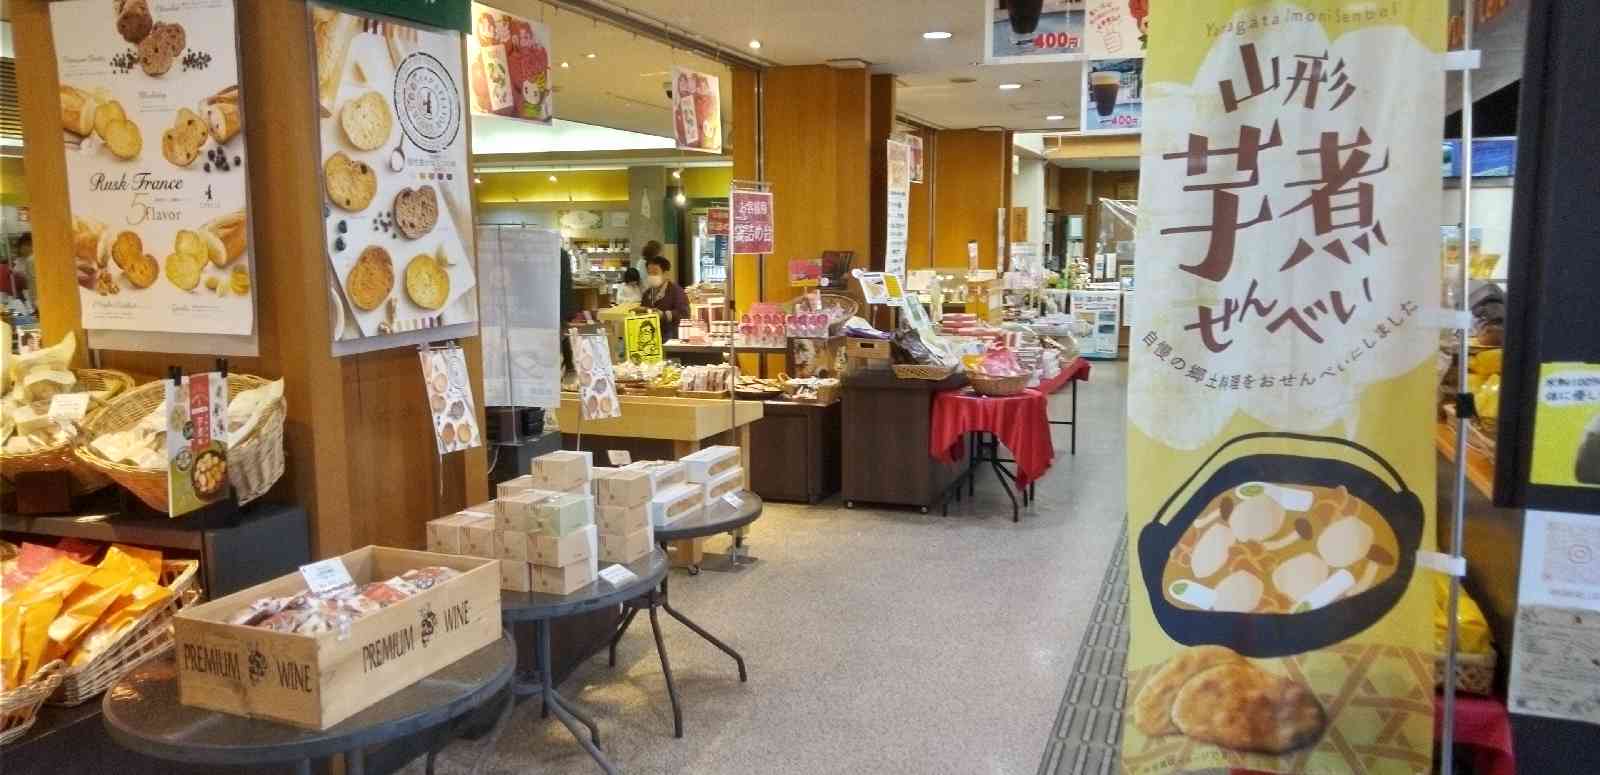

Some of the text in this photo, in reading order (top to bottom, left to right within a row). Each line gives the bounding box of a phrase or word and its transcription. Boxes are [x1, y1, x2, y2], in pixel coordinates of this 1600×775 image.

[1219, 43, 1356, 113] 山形
[89, 171, 183, 192] Rusk France
[1160, 118, 1389, 282] 芋煮
[1185, 278, 1373, 353] せんべい
[183, 643, 313, 693] PREMIUM WINE
[362, 599, 472, 672] PREMIUM WINE
